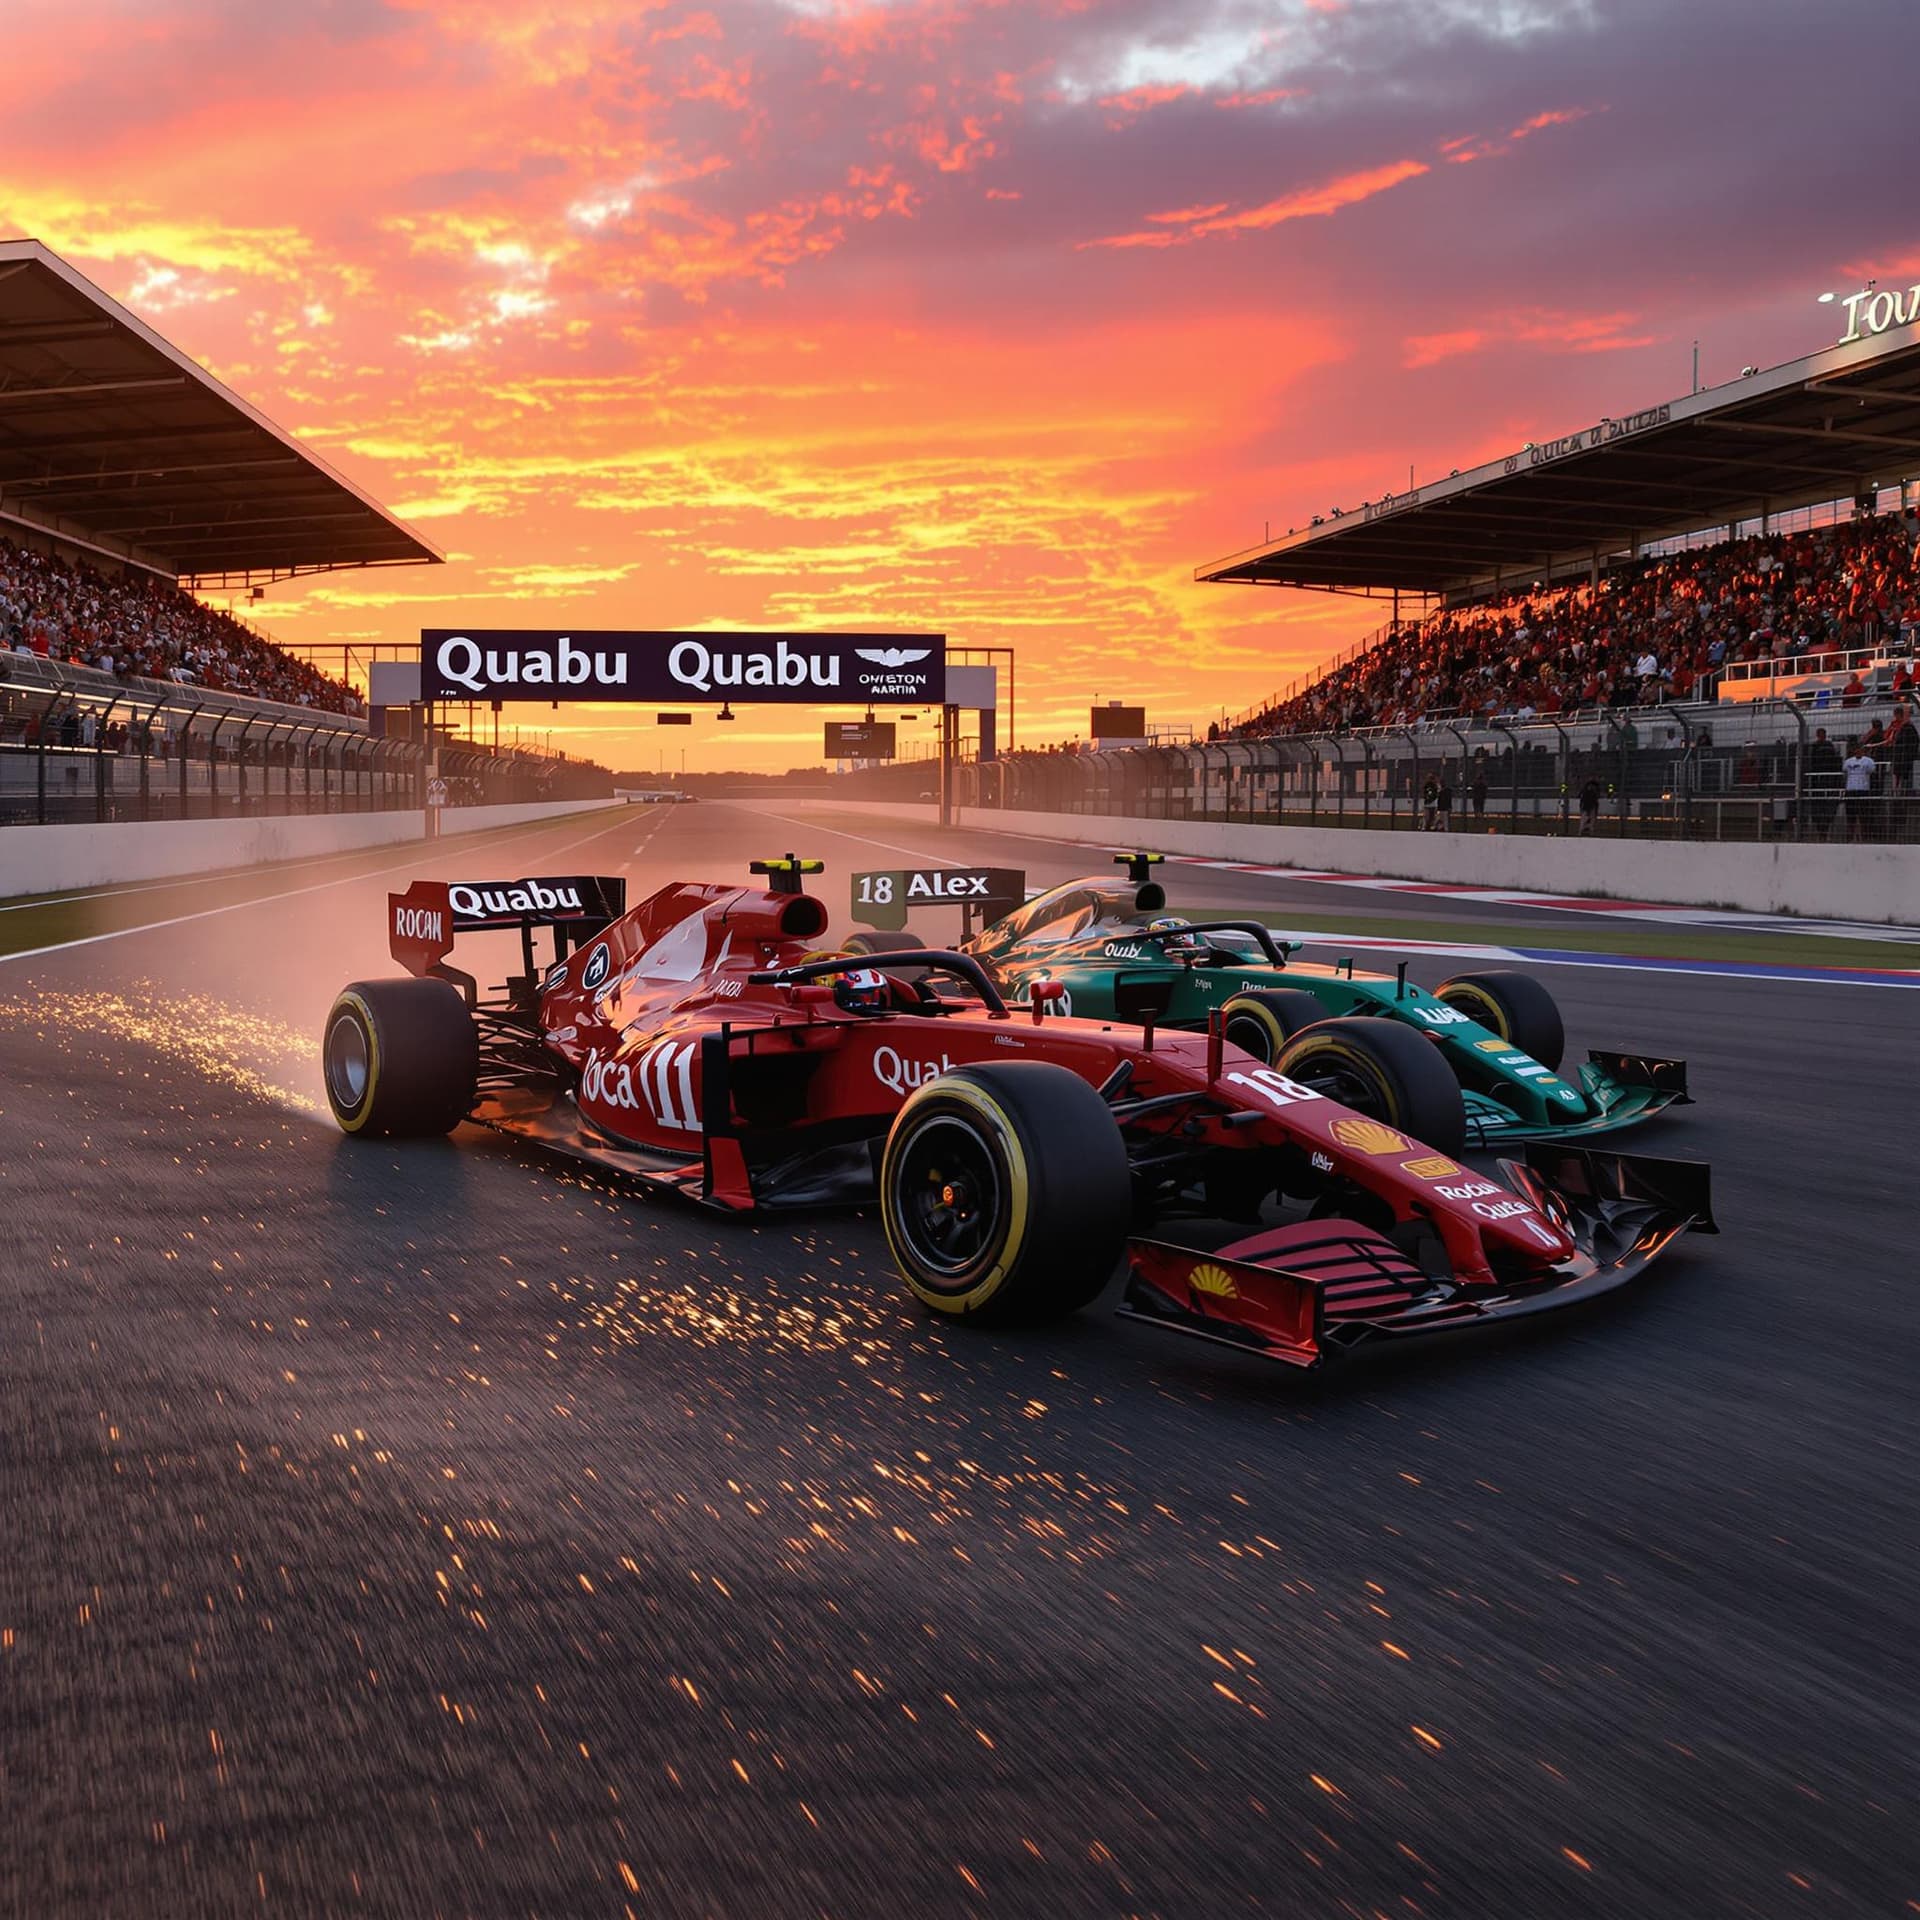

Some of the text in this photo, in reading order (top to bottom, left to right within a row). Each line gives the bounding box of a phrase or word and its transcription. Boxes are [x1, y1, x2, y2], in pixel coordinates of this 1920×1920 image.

[436, 637, 840, 692] Quabu Quabu
[449, 880, 583, 919] Quabu
[857, 876, 893, 904] 18
[1226, 1069, 1324, 1107] 18
